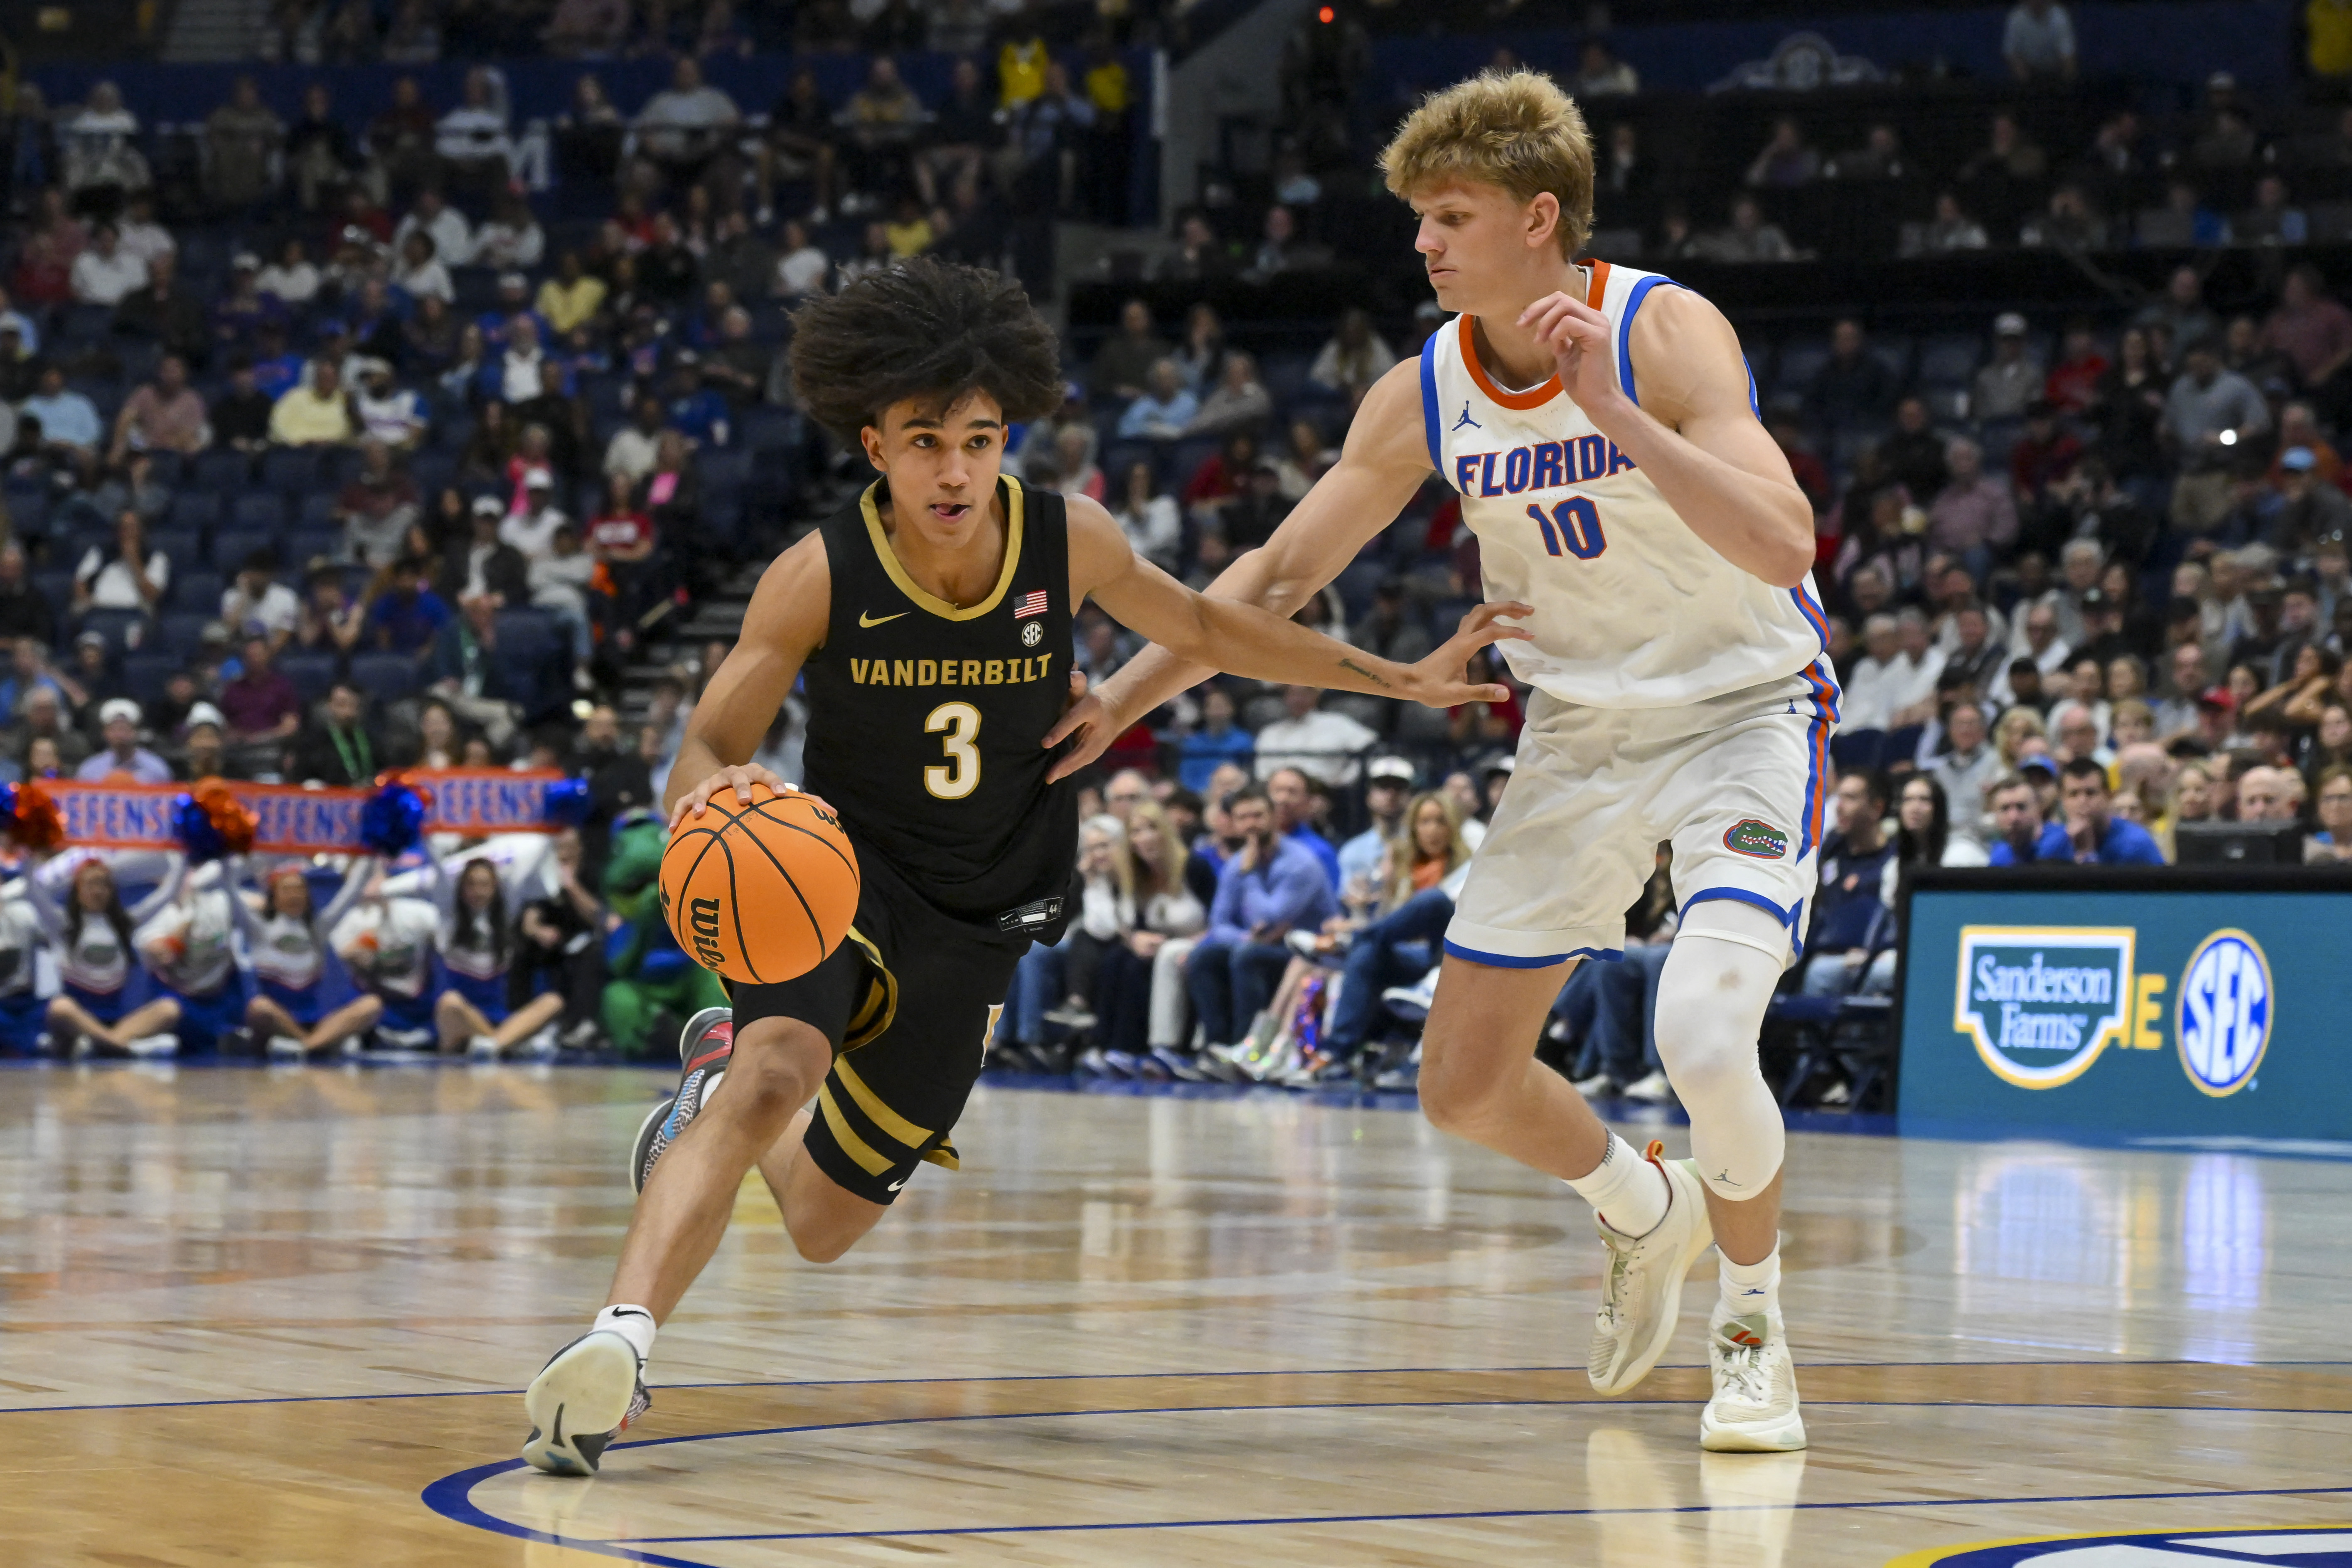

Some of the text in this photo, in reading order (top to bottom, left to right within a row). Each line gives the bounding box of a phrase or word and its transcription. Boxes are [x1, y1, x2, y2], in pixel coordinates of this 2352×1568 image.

[1455, 433, 1638, 498] FLORIDA
[1526, 495, 1608, 560] 10
[1024, 624, 1041, 644] SEC
[850, 652, 1052, 686] VANDERBILT
[923, 701, 982, 800] 3
[52, 793, 180, 838] EFENS
[236, 795, 362, 844] EFENS
[1049, 904, 1057, 914] 44
[1975, 952, 2112, 1005] Sanderson
[1998, 1002, 2084, 1051] Farms
[2119, 973, 2167, 1050] E
[2183, 941, 2265, 1083] SEC
